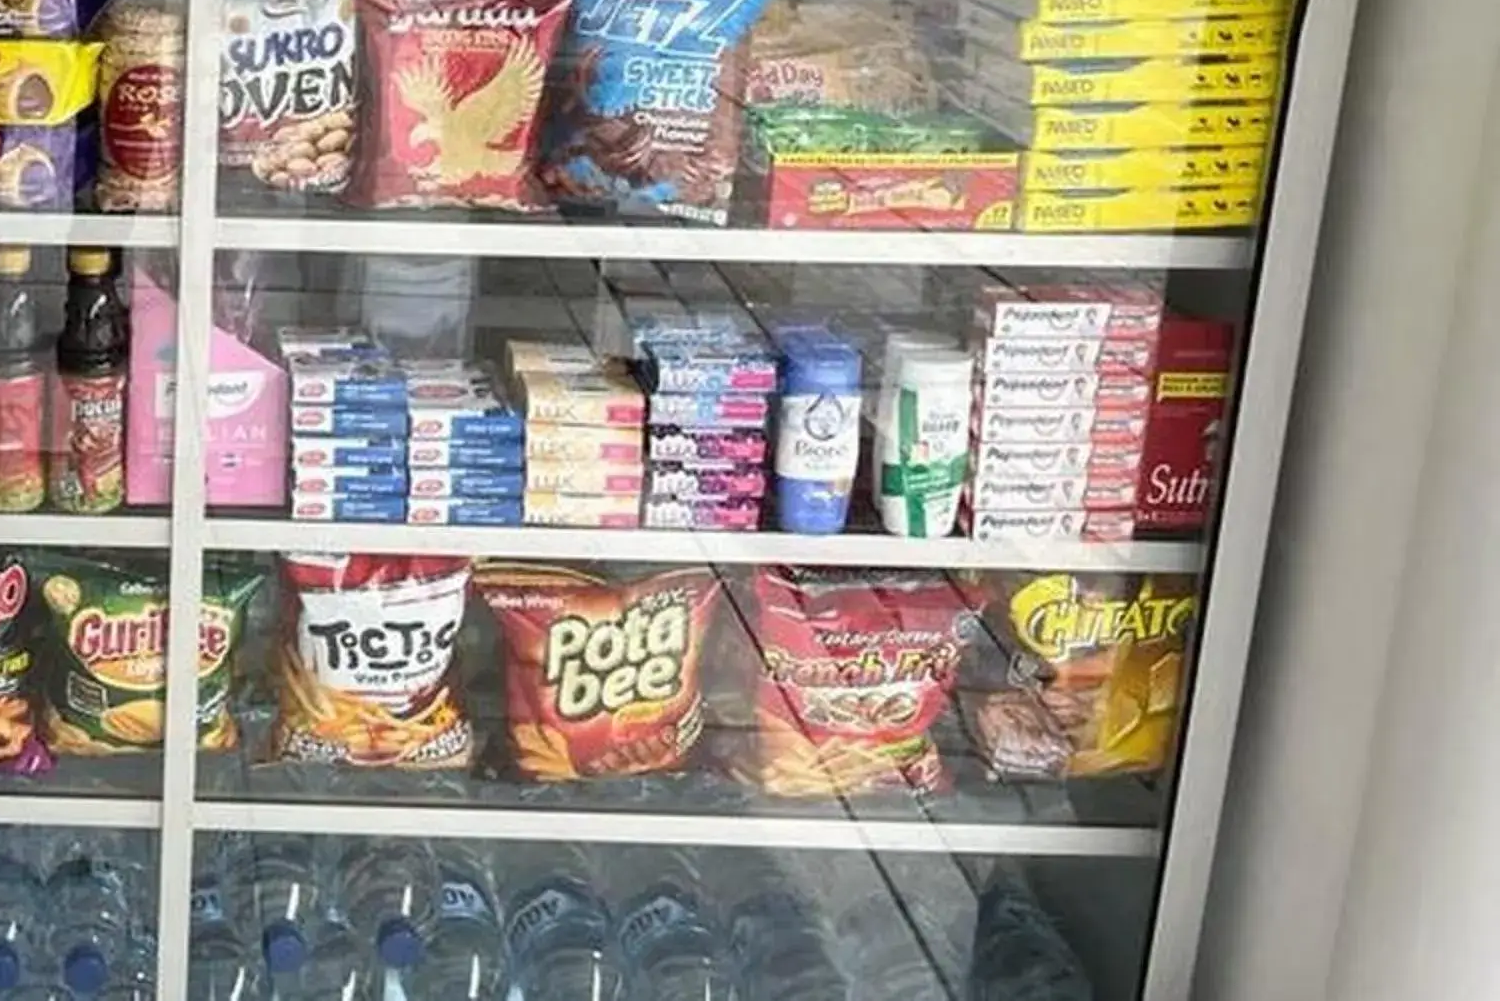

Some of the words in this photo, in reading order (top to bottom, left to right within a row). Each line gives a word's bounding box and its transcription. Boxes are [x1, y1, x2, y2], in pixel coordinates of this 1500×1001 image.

[228, 25, 344, 73] SUKRO
[624, 57, 717, 88] SWEET
[783, 60, 825, 88] Day
[638, 85, 717, 112] STICK
[546, 605, 686, 680] Pota
[558, 655, 678, 717] bee
